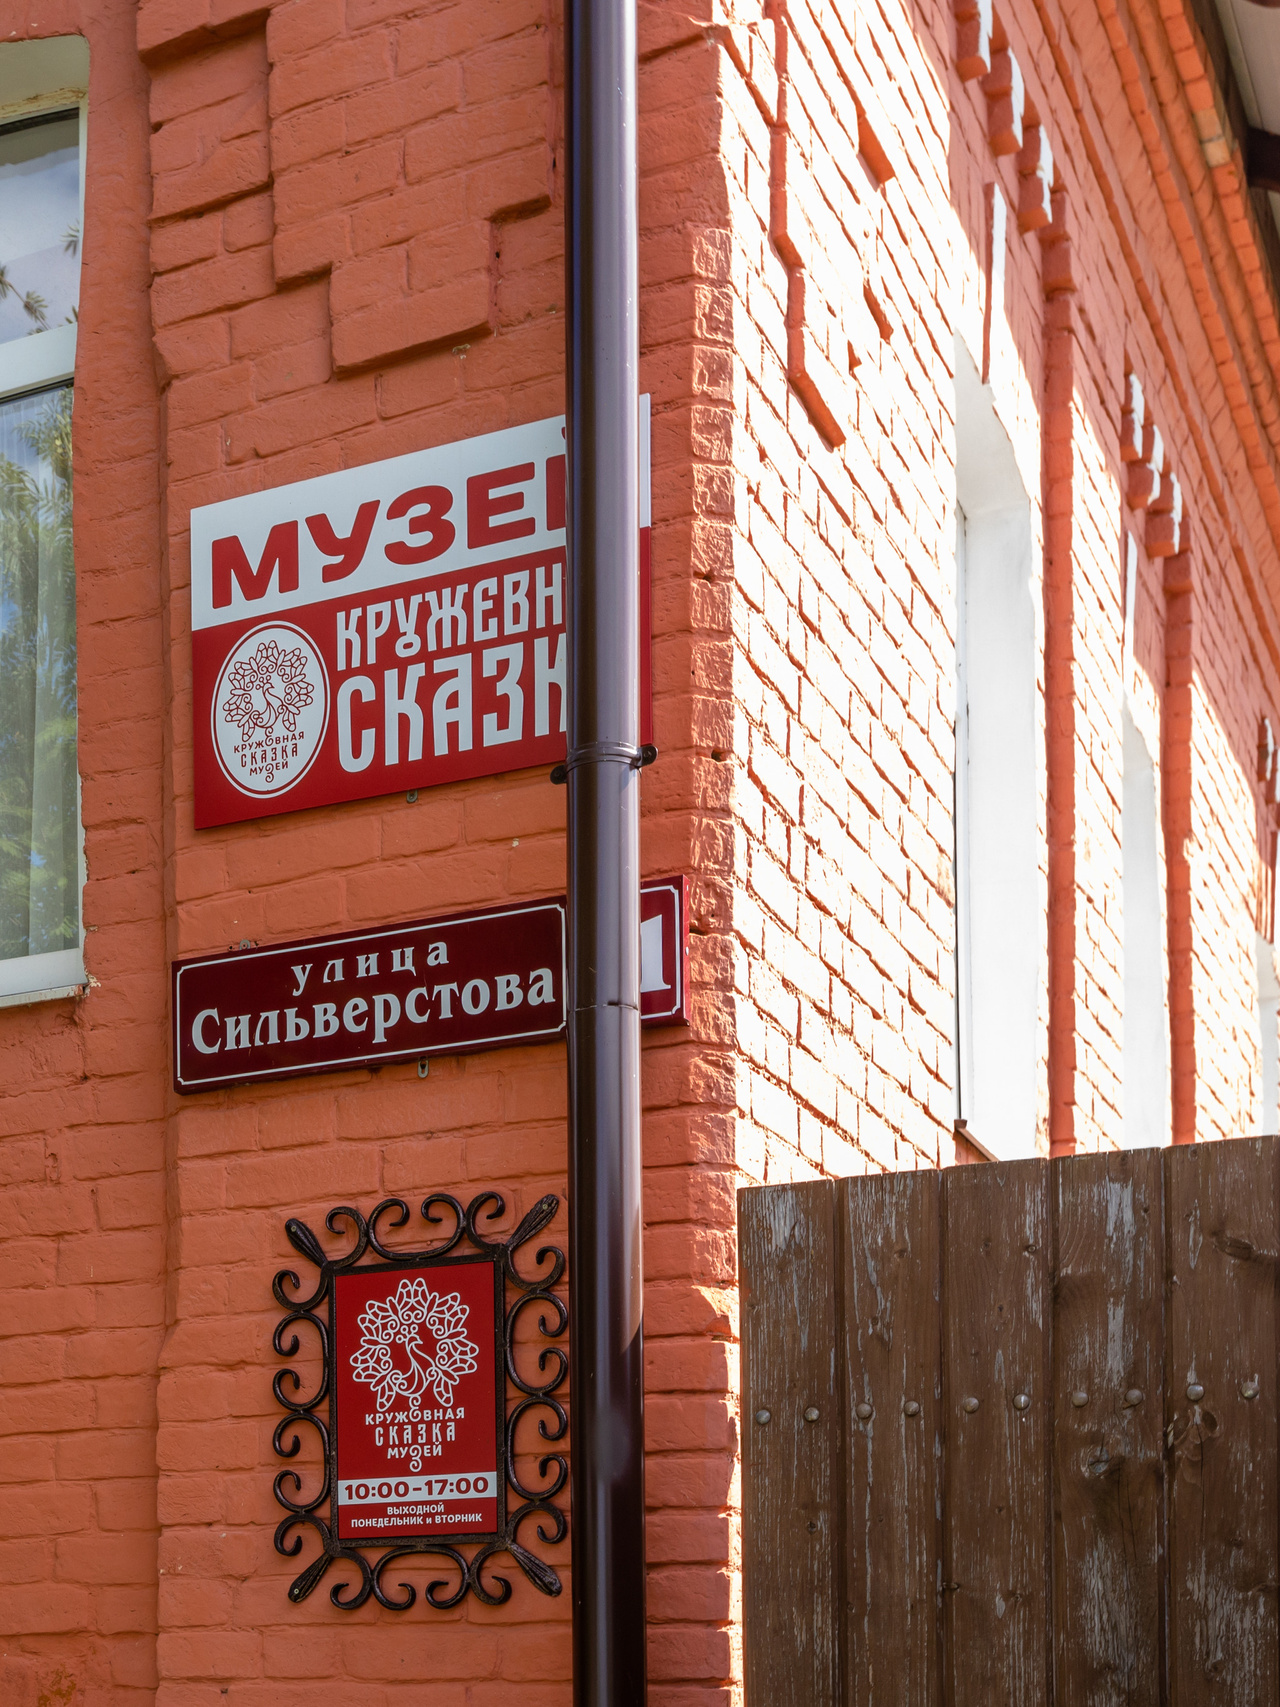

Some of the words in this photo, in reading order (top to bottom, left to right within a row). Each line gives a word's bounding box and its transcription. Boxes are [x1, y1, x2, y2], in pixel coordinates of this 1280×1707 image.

[211, 426, 566, 610] МУЗЕ
[336, 563, 563, 671] КРУЖЕВН
[336, 633, 566, 773] СКАЗК
[240, 743, 298, 768] СКАЗКА
[249, 758, 289, 783] МУЗЕЙ
[291, 941, 450, 996] улица
[191, 967, 556, 1054] Сильверстова
[375, 1422, 456, 1447] СКАЗКА
[387, 1442, 442, 1472] МУЗЕЙ
[351, 1517, 423, 1528] ПОНЕДЕЛЬНИК
[435, 1513, 483, 1524] ВТОРНИК
[387, 1502, 445, 1515] ВЫХОДНОЙ
